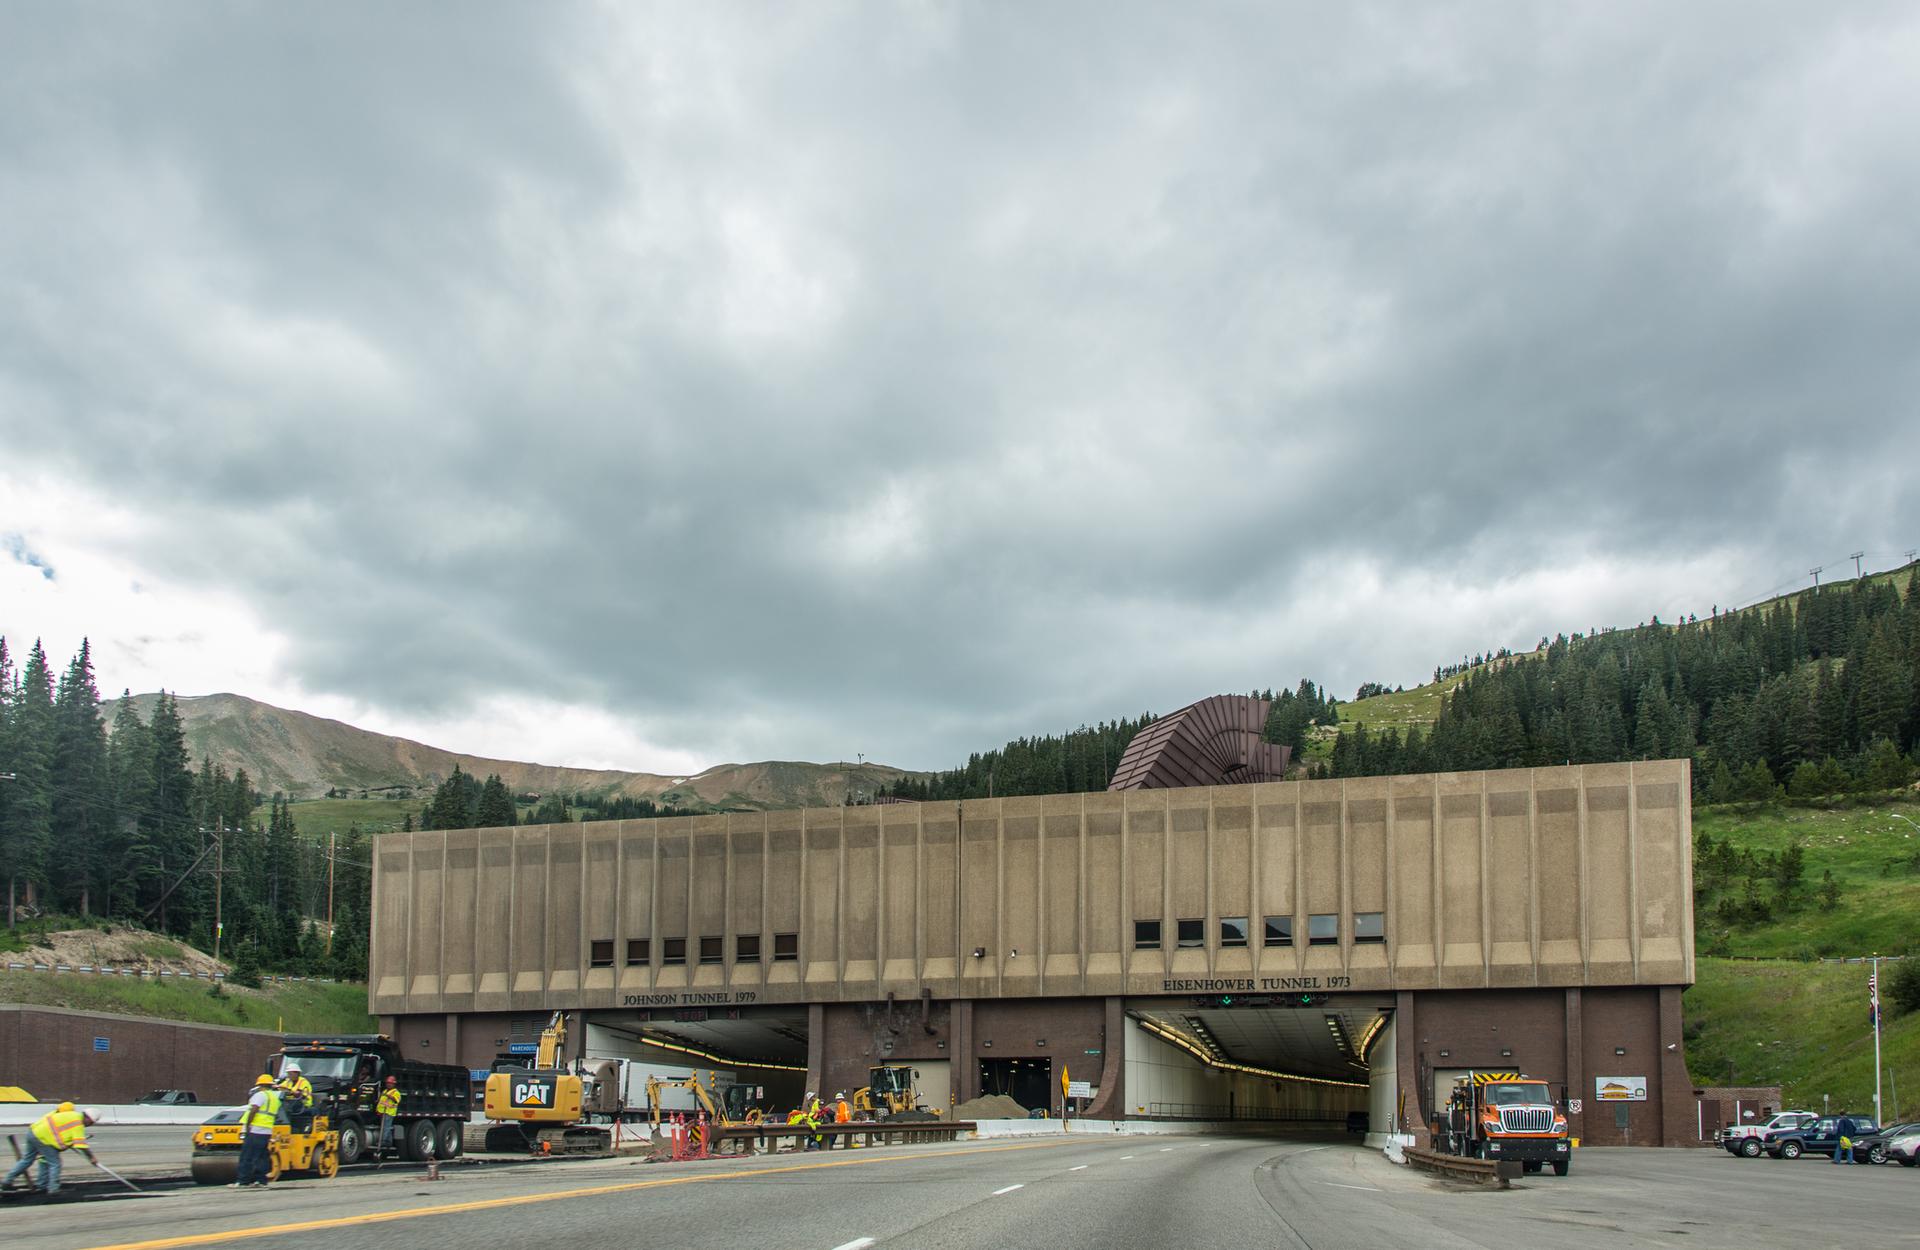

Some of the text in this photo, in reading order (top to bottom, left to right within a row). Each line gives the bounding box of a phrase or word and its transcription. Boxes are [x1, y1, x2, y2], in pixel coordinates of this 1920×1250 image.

[1164, 976, 1350, 991] EISENHOWER TUNNEL 1973
[624, 992, 756, 1005] JOHNSON TUNNEL 1979
[515, 1084, 550, 1104] CAT
